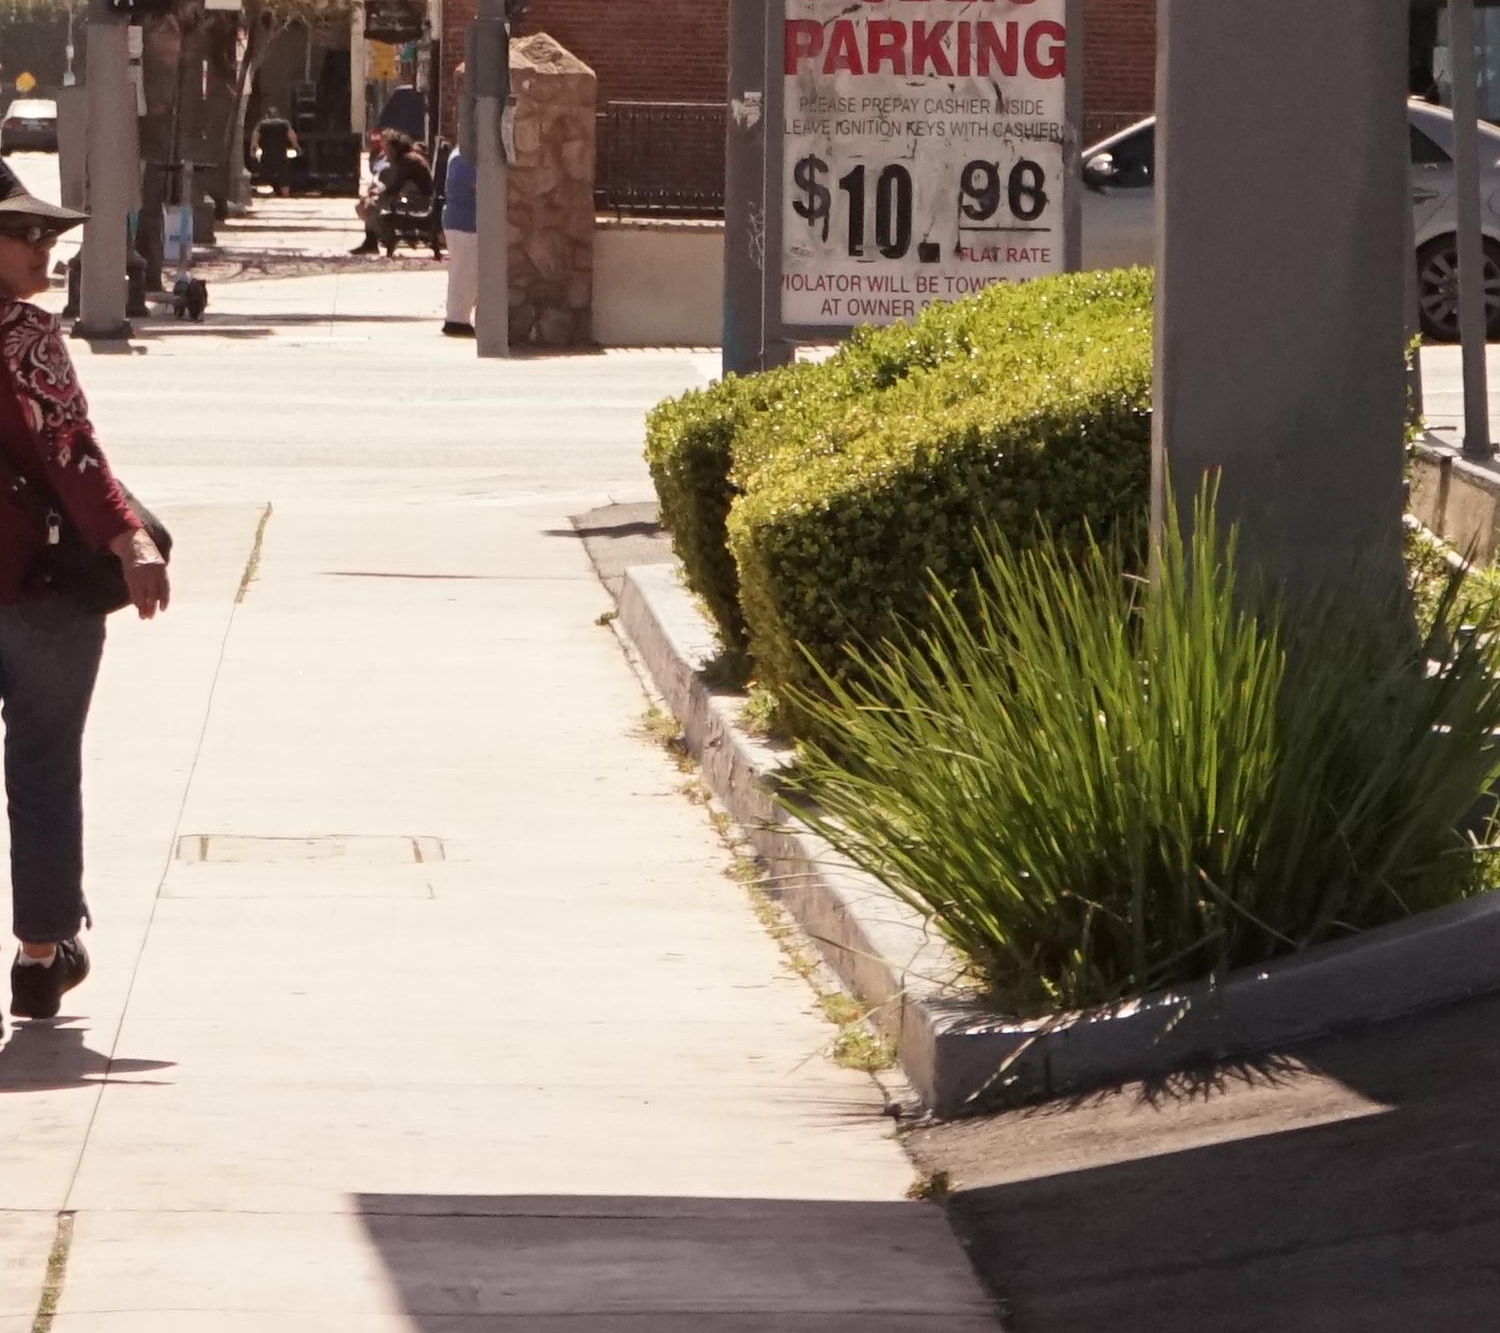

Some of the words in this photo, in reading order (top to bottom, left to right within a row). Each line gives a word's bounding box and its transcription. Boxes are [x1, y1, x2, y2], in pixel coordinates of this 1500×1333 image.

[784, 18, 1066, 80] PARKING
[799, 97, 856, 114] PLEASE
[861, 97, 919, 115] PREPAY
[923, 98, 991, 116] CASHIER
[994, 99, 1045, 116] INSIDE
[784, 119, 831, 135] LEAVE
[835, 119, 902, 136] IGNITION
[906, 120, 946, 136] KEYS
[950, 121, 990, 137] WITH
[958, 245, 999, 264] FLAT
[1006, 247, 1052, 264] RATE
[865, 275, 910, 294] WILL
[916, 276, 939, 295] BE
[820, 298, 843, 316] AT
[847, 299, 915, 317] OWNER
